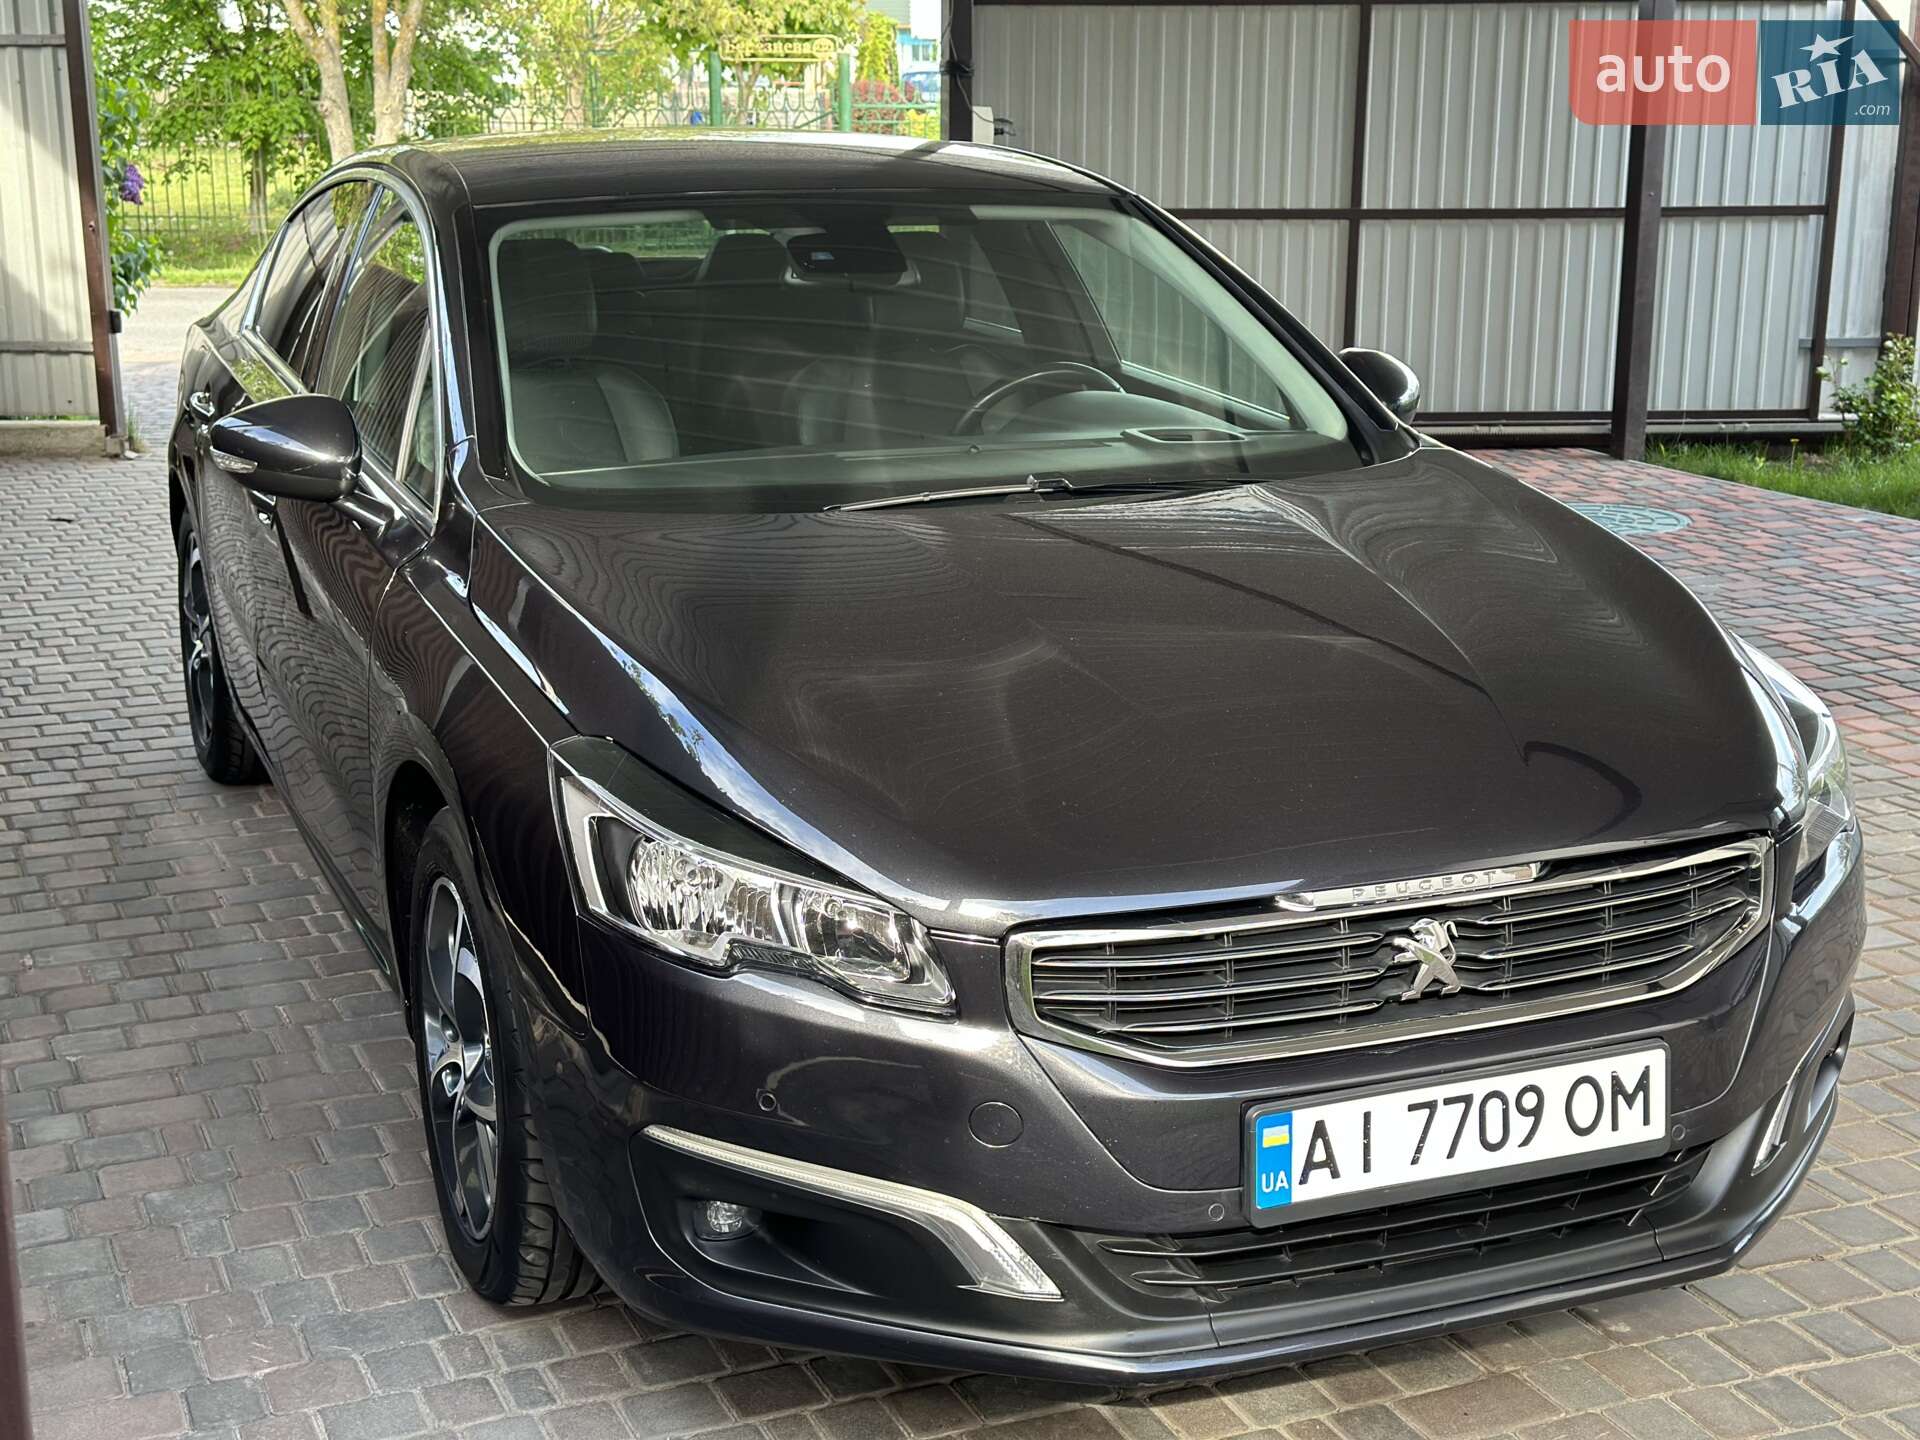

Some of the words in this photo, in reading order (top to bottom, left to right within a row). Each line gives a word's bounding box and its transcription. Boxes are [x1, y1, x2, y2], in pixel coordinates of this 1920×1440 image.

[1352, 870, 1497, 901] PEUGEOT
[1299, 1110, 1372, 1186] AI
[1407, 1084, 1546, 1166] 7709
[1565, 1065, 1651, 1137] OM
[1261, 1172, 1289, 1193] UA
